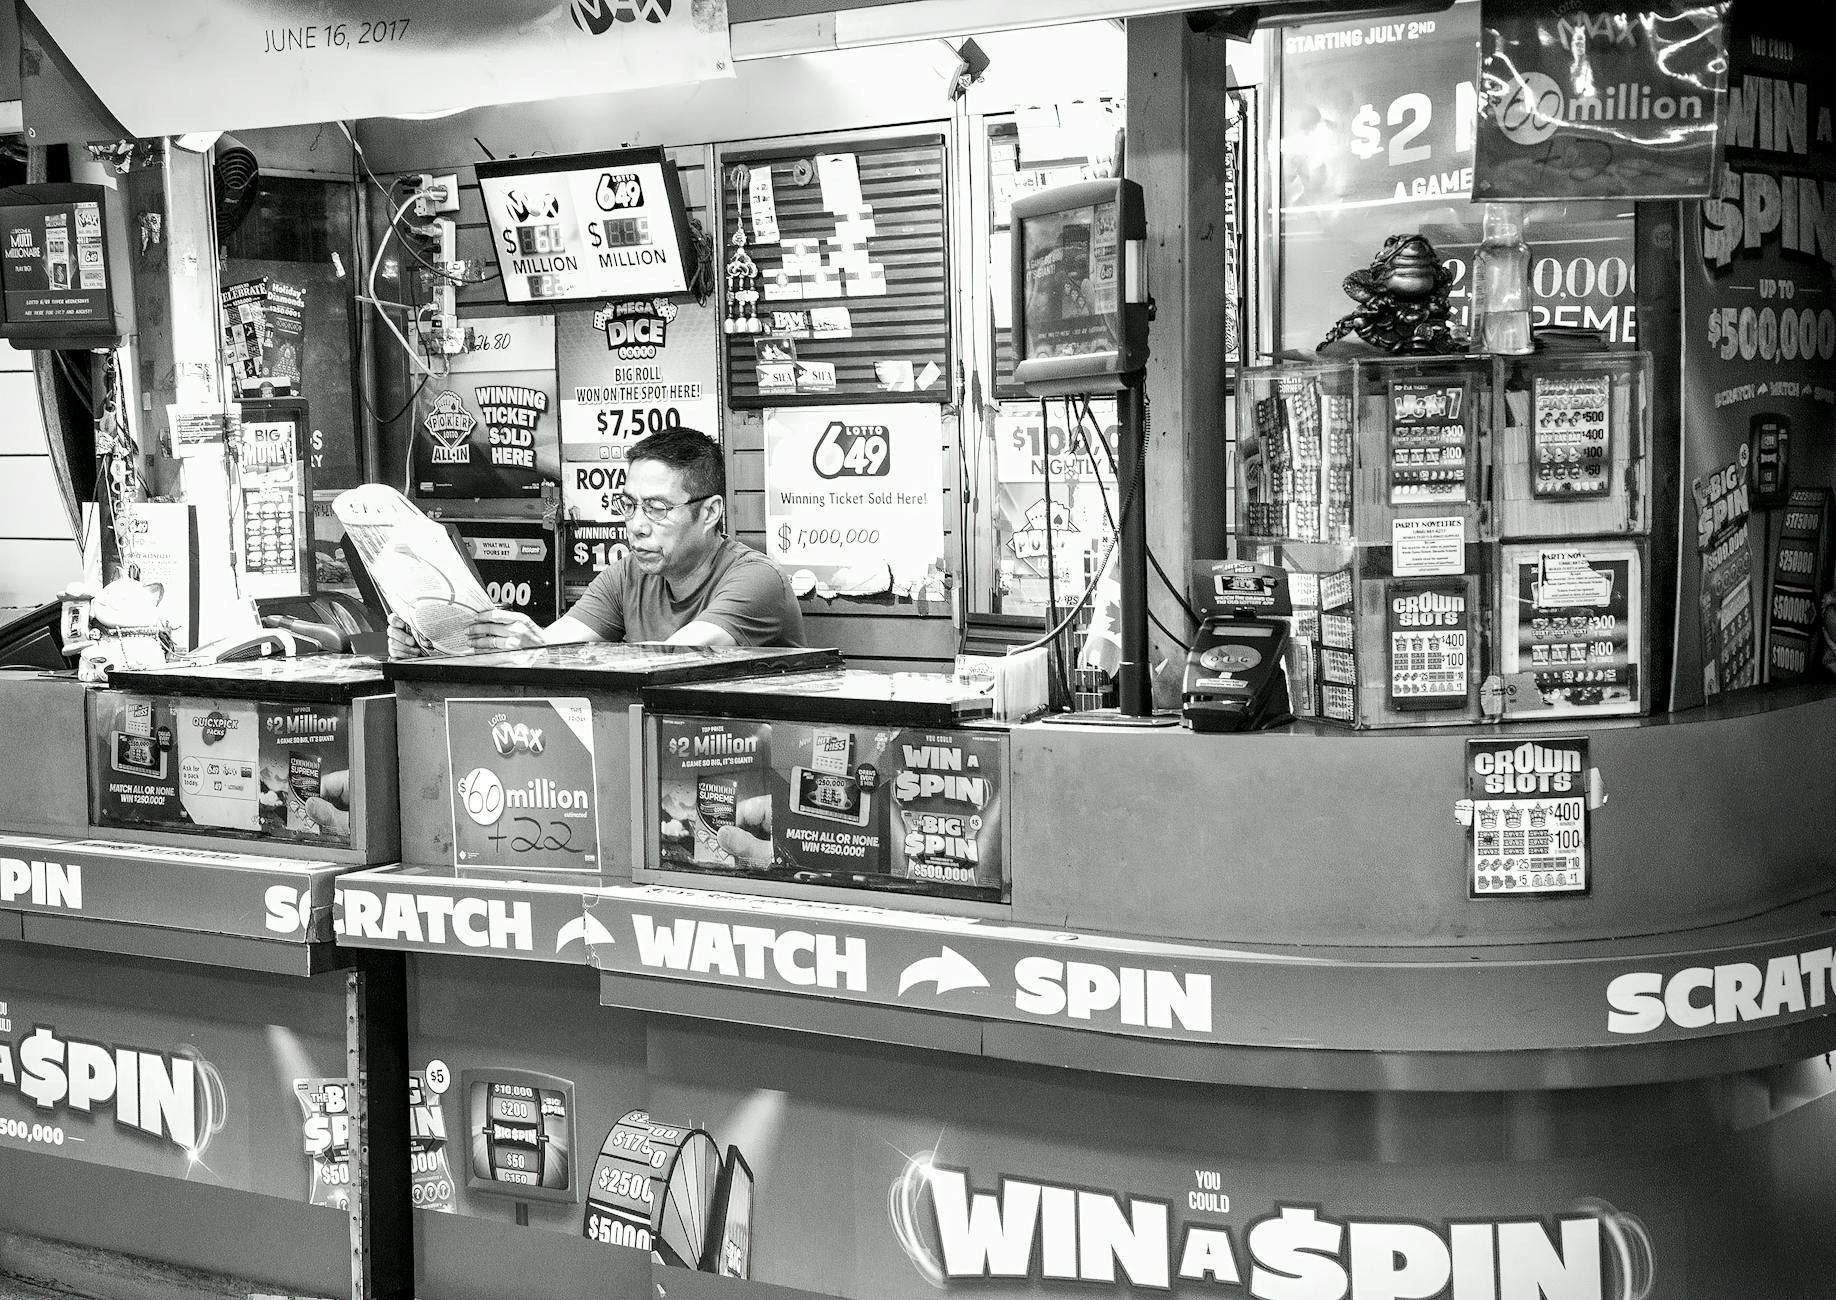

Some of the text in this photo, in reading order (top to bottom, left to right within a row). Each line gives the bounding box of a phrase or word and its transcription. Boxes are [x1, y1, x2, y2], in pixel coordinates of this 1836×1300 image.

[264, 19, 410, 53] JUNE 16, 2017
[1285, 20, 1435, 54] STARTING JULY 2ND
[1569, 83, 1701, 120] million
[1725, 75, 1834, 154] WIN A
[1351, 92, 1432, 166] $2
[612, 174, 635, 183] LOTTO
[1393, 168, 1473, 200] A GAME
[503, 227, 517, 255] $
[588, 222, 602, 248] $
[513, 256, 578, 274] MILLION
[599, 250, 667, 268] MILLION
[272, 283, 301, 299] Holiday
[1759, 279, 1795, 299] UP TO
[267, 291, 305, 308] Diamonds
[616, 302, 654, 317] MEGA
[607, 318, 665, 347] DICE
[1707, 306, 1836, 364] $500,000
[619, 346, 656, 359] LOTTO
[615, 367, 661, 382] BIG ROLL
[475, 386, 546, 410] WINNING
[577, 384, 700, 402] WON ON THE SPOT HERE!
[431, 414, 469, 431] POKER
[483, 406, 537, 427] TICKET
[597, 408, 680, 439] $7,500
[1583, 411, 1604, 422] $500
[255, 429, 280, 442] BIG
[490, 427, 532, 447] SOLD
[846, 426, 883, 436] LOTTO
[1441, 425, 1464, 438] $300
[1583, 429, 1604, 439] $400
[243, 442, 293, 464] MONEY
[492, 447, 534, 467] HERE
[1442, 446, 1462, 459] $100
[1584, 447, 1603, 458] $100
[1585, 465, 1601, 475] $50
[576, 469, 627, 490] ROYA
[1710, 464, 1738, 502] BIG
[781, 492, 927, 507] Winning Ticket Sold Here!
[1421, 520, 1462, 528] NOVELTIES
[574, 527, 615, 540] WINNING
[778, 523, 880, 553] $ 1,000,000
[1393, 591, 1465, 613] CROWN
[1400, 612, 1458, 626] SLOTS
[1589, 615, 1616, 630] $300
[1442, 634, 1464, 647] $400
[1590, 641, 1614, 656] $100
[1442, 652, 1464, 666] $100
[1419, 672, 1464, 681] $25 $10
[192, 716, 239, 730] QUICKPICK
[266, 713, 338, 735] $2 Million
[487, 713, 507, 727] Lotto
[207, 728, 225, 736] PACKS
[492, 722, 545, 754] MAX
[937, 735, 953, 743] COULD
[669, 733, 759, 757] $2 Million
[817, 736, 831, 746] HIT
[825, 739, 846, 752] MISS
[902, 744, 980, 771] WIN A
[1474, 742, 1581, 775] CROWN
[291, 766, 318, 778] SUPREME
[858, 769, 876, 777] DRAWS
[109, 783, 155, 795] MATCH ALL OR
[1484, 772, 1572, 793] SLOTS
[121, 794, 133, 803] WIN
[506, 778, 589, 809] million
[699, 791, 734, 804] SUPREME
[1549, 802, 1580, 821] $400
[922, 815, 962, 836] BIG
[971, 819, 979, 827] $5
[787, 828, 818, 841] MATCH
[819, 831, 836, 843] ALL
[836, 833, 851, 845] OR
[1549, 830, 1580, 849] $100
[801, 840, 866, 858] WIN $250,000!
[1516, 857, 1580, 869] $25 $10
[0, 858, 82, 910] PIN
[1519, 873, 1578, 885] $5 $1
[632, 914, 1213, 1032] WATCH SPIN
[1607, 946, 1836, 1035] SCRAT
[430, 1070, 444, 1083] $5
[310, 1093, 329, 1103] THE
[495, 1084, 533, 1098] $10,000
[501, 1102, 528, 1118] $200
[544, 1098, 560, 1106] BIG
[506, 1153, 525, 1169] $50
[504, 1173, 527, 1185] $150
[1195, 1170, 1221, 1190] YOU
[1188, 1191, 1230, 1213] COULD
[931, 1168, 1169, 1289] WIN
[1179, 1228, 1241, 1285] A
